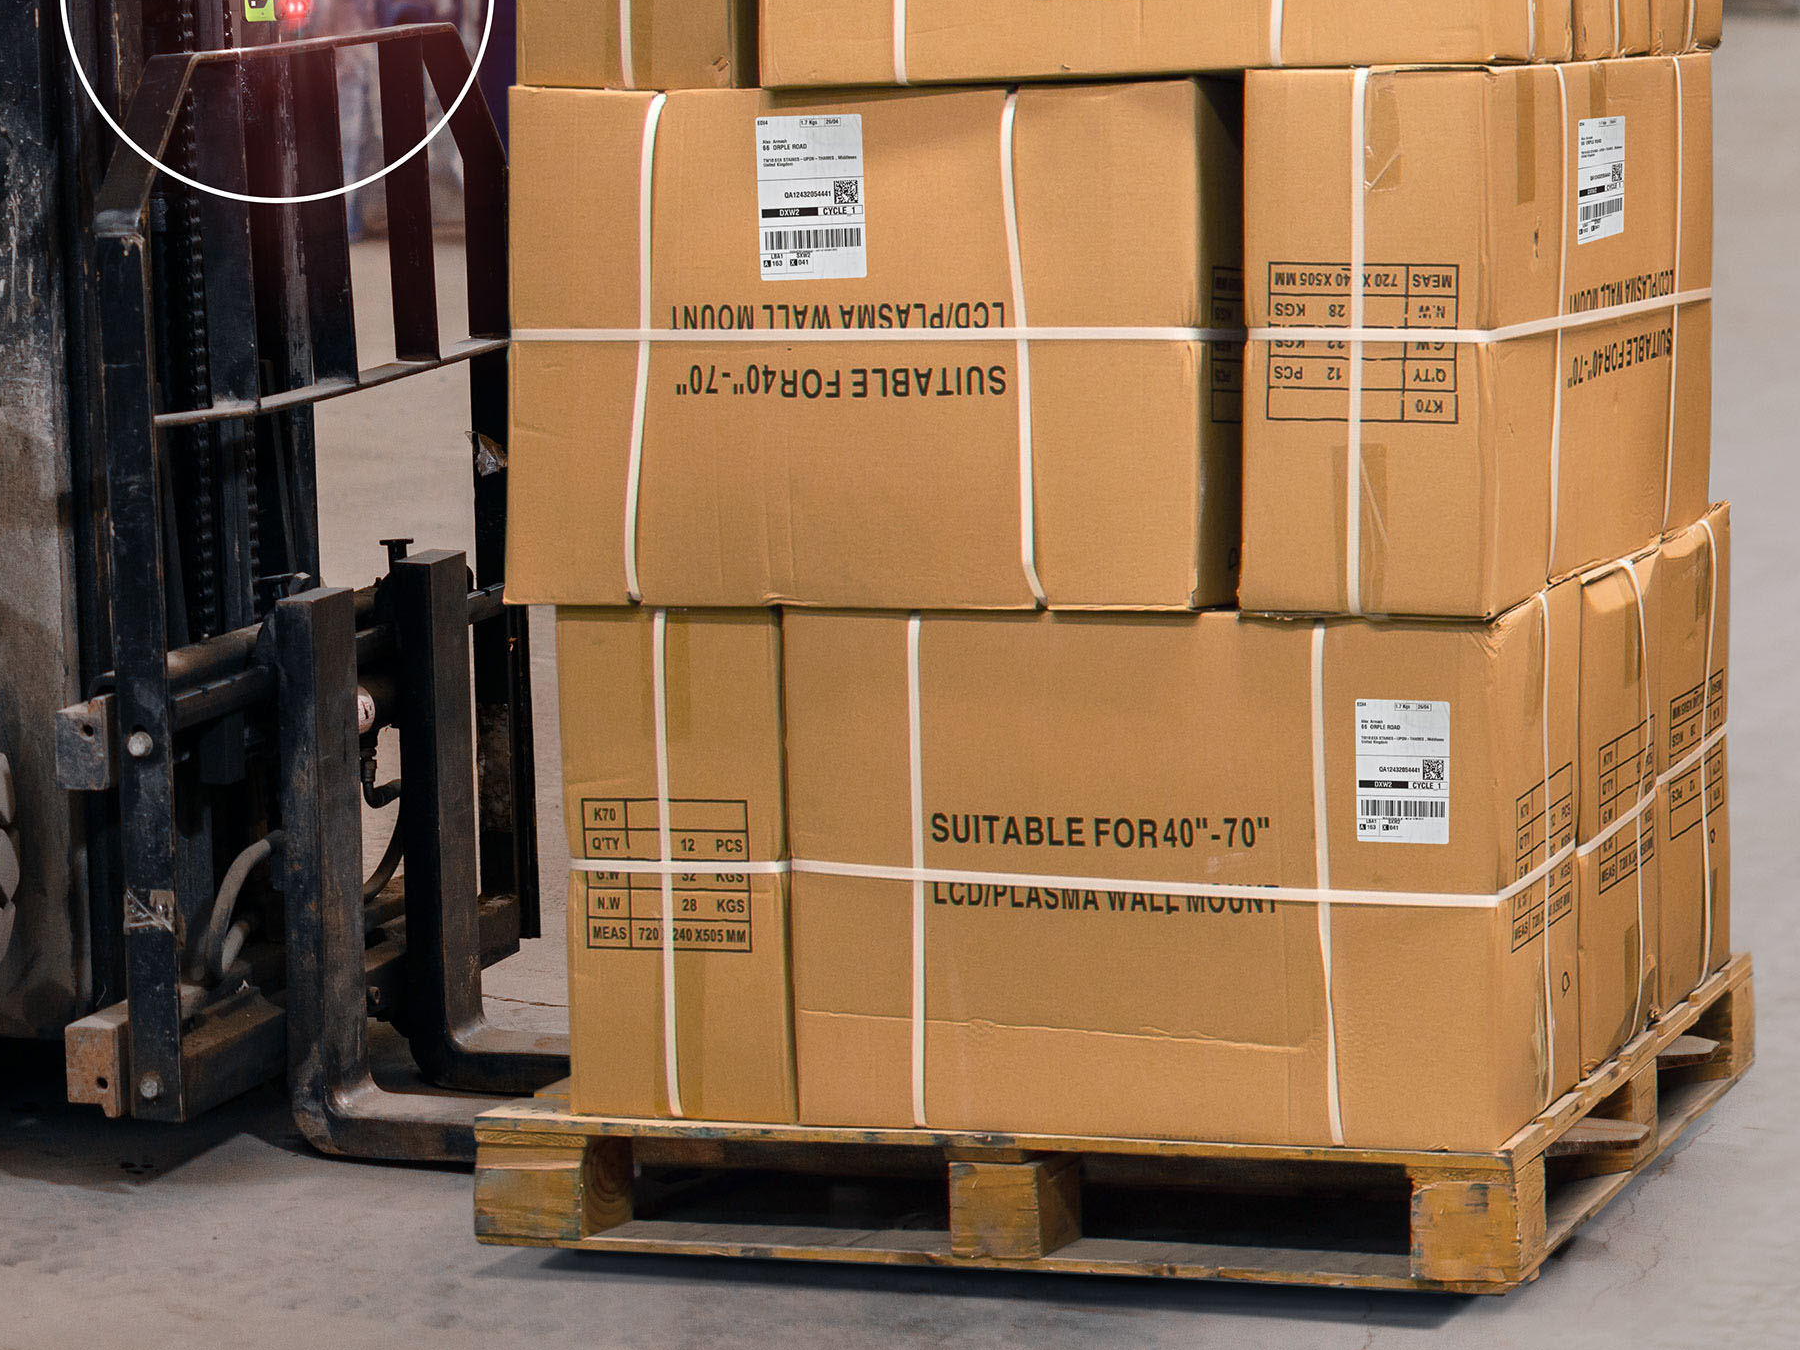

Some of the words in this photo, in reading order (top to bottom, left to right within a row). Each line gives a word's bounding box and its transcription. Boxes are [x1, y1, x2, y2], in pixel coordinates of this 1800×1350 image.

[1275, 272, 1296, 286] MM
[1375, 274, 1398, 287] 720
[1413, 274, 1452, 288] MEAS
[763, 304, 831, 329] WALL
[840, 302, 1004, 329] LCD/PLASMA
[1275, 303, 1306, 316] KGS
[1328, 304, 1345, 317] 28
[1274, 366, 1303, 380] PCS
[1327, 367, 1342, 380] 12
[1413, 368, 1446, 382] Q'TY
[851, 366, 1006, 398] SUITABLE
[1416, 399, 1443, 413] K70
[594, 808, 616, 821] K70
[932, 813, 1085, 847] SUITABLE
[592, 837, 619, 850] Q'TY
[681, 839, 695, 851] 12
[716, 840, 743, 852] PCS
[597, 897, 620, 910] N.W
[682, 899, 697, 911] 28
[717, 900, 745, 913] KGS
[933, 882, 1099, 911] LCD/PLASMA
[1107, 891, 1179, 914] WALL
[1187, 884, 1279, 914] MOUNT
[593, 926, 627, 939] MEAS
[638, 927, 659, 940] 720
[673, 928, 692, 941] 240
[726, 930, 746, 943] MM
